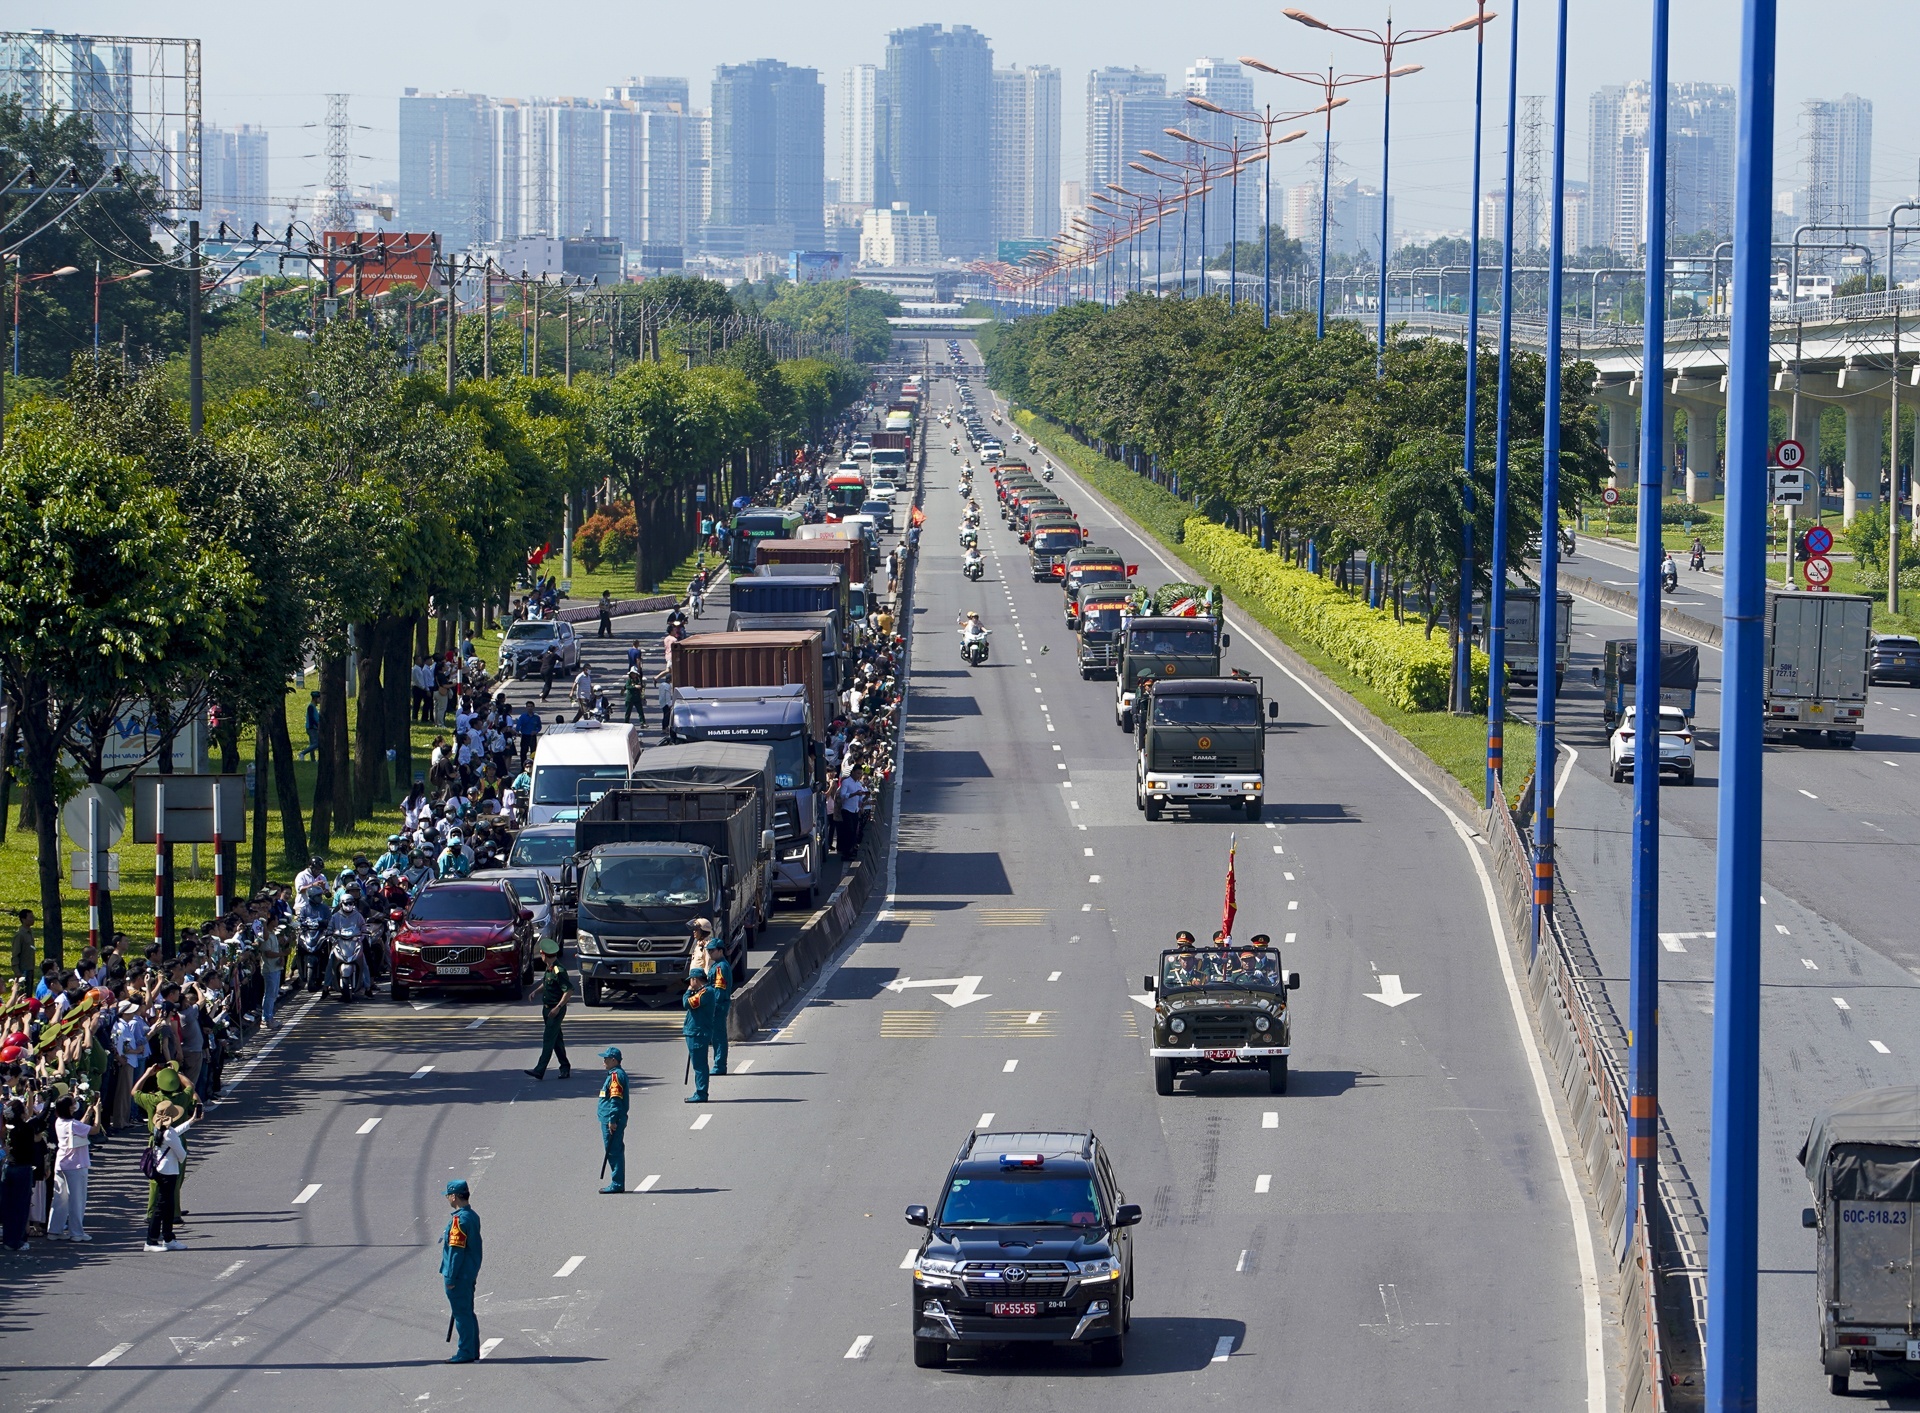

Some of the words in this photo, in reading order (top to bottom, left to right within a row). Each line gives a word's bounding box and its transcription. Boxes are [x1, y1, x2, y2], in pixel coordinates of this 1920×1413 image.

[1784, 449, 1796, 461] 60
[1606, 492, 1614, 500] 60
[1843, 1209, 1907, 1224] 60C-618.23
[994, 1303, 1036, 1314] KP-55-55
